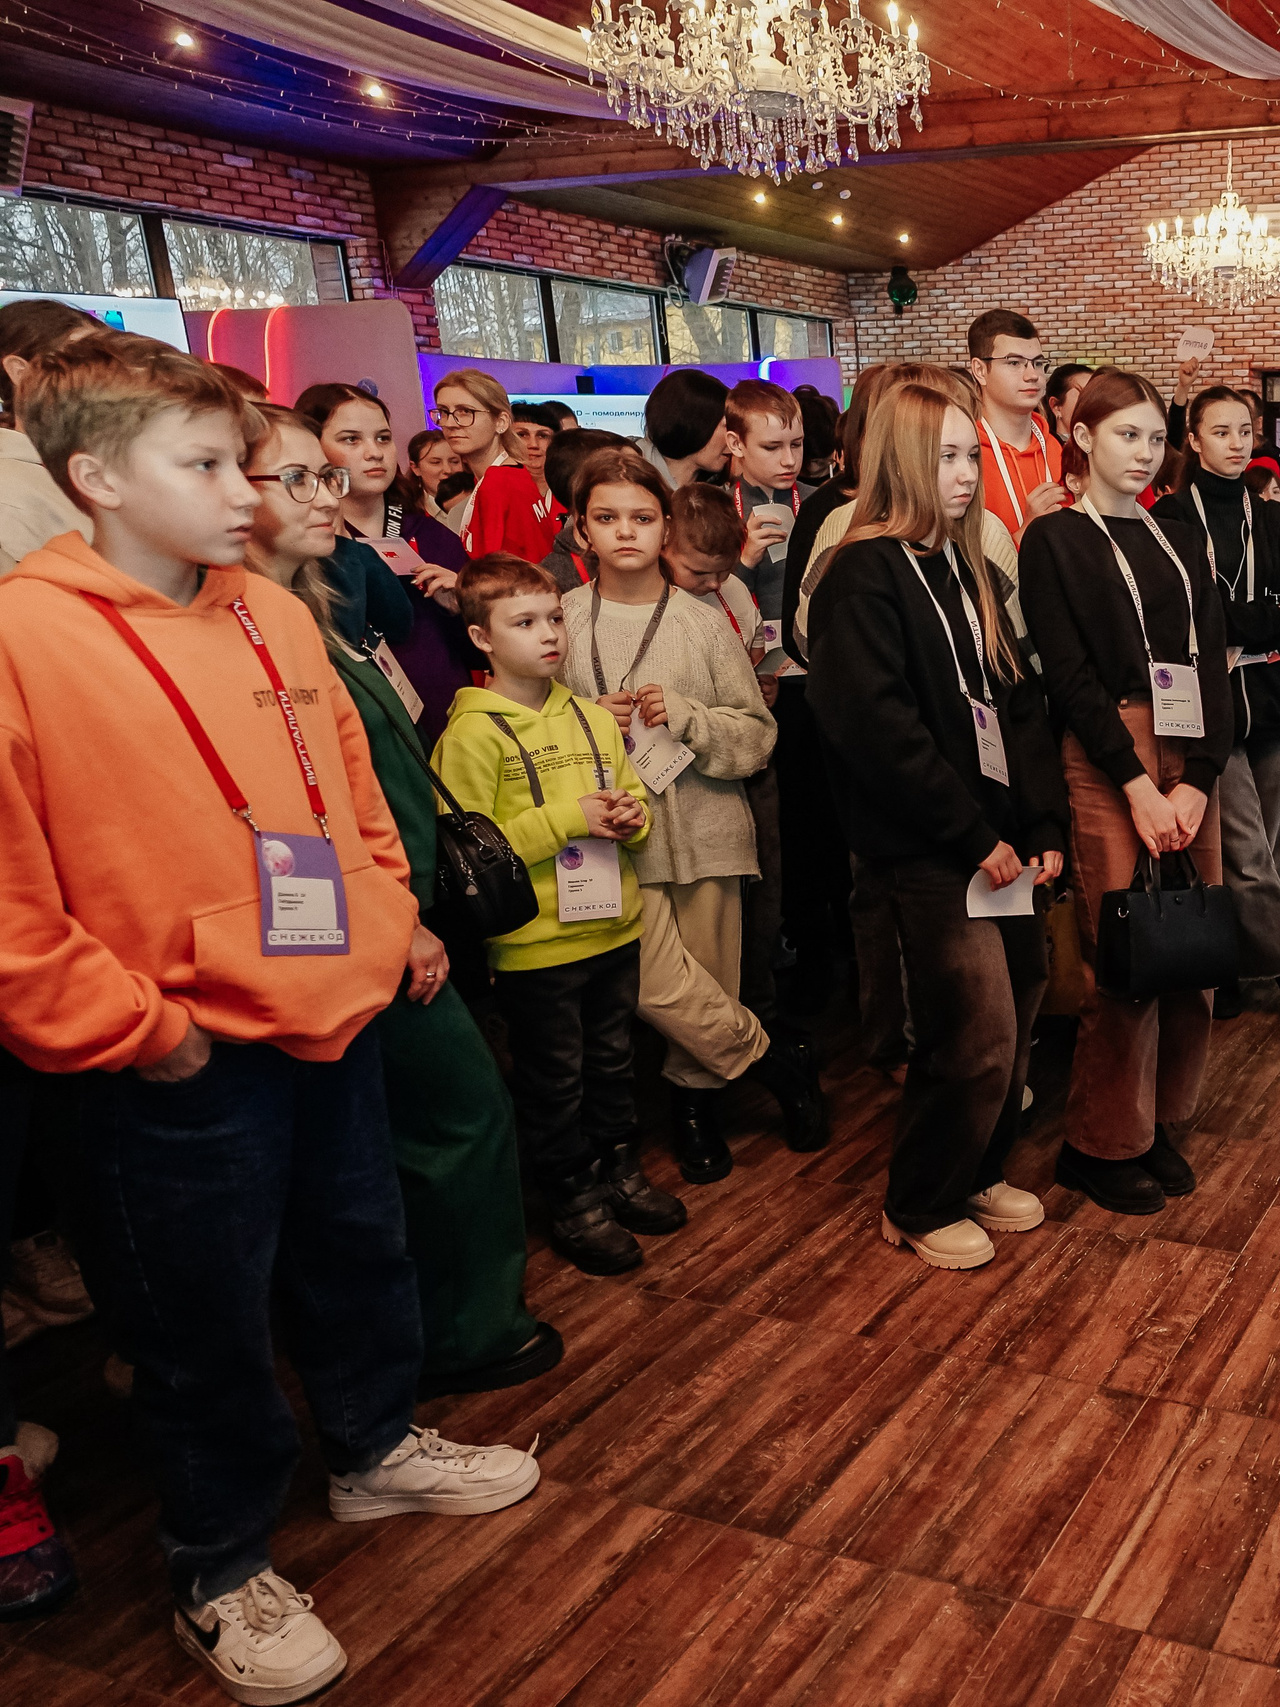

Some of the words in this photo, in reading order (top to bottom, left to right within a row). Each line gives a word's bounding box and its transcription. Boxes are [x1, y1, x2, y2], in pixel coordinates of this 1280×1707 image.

[592, 410, 645, 418] помоделиру
[1143, 515, 1176, 558] ВИРТУАЛИТИ
[232, 598, 265, 646] ВИРТУ
[1159, 721, 1201, 730] СНЕЖЕКОД
[277, 691, 318, 786] ВИРТУАЛИТИ
[652, 750, 688, 785] СНЕЖЕКОД
[564, 902, 617, 913] СНЕЖЕКОД
[269, 932, 343, 942] СНЕЖЕКОД
